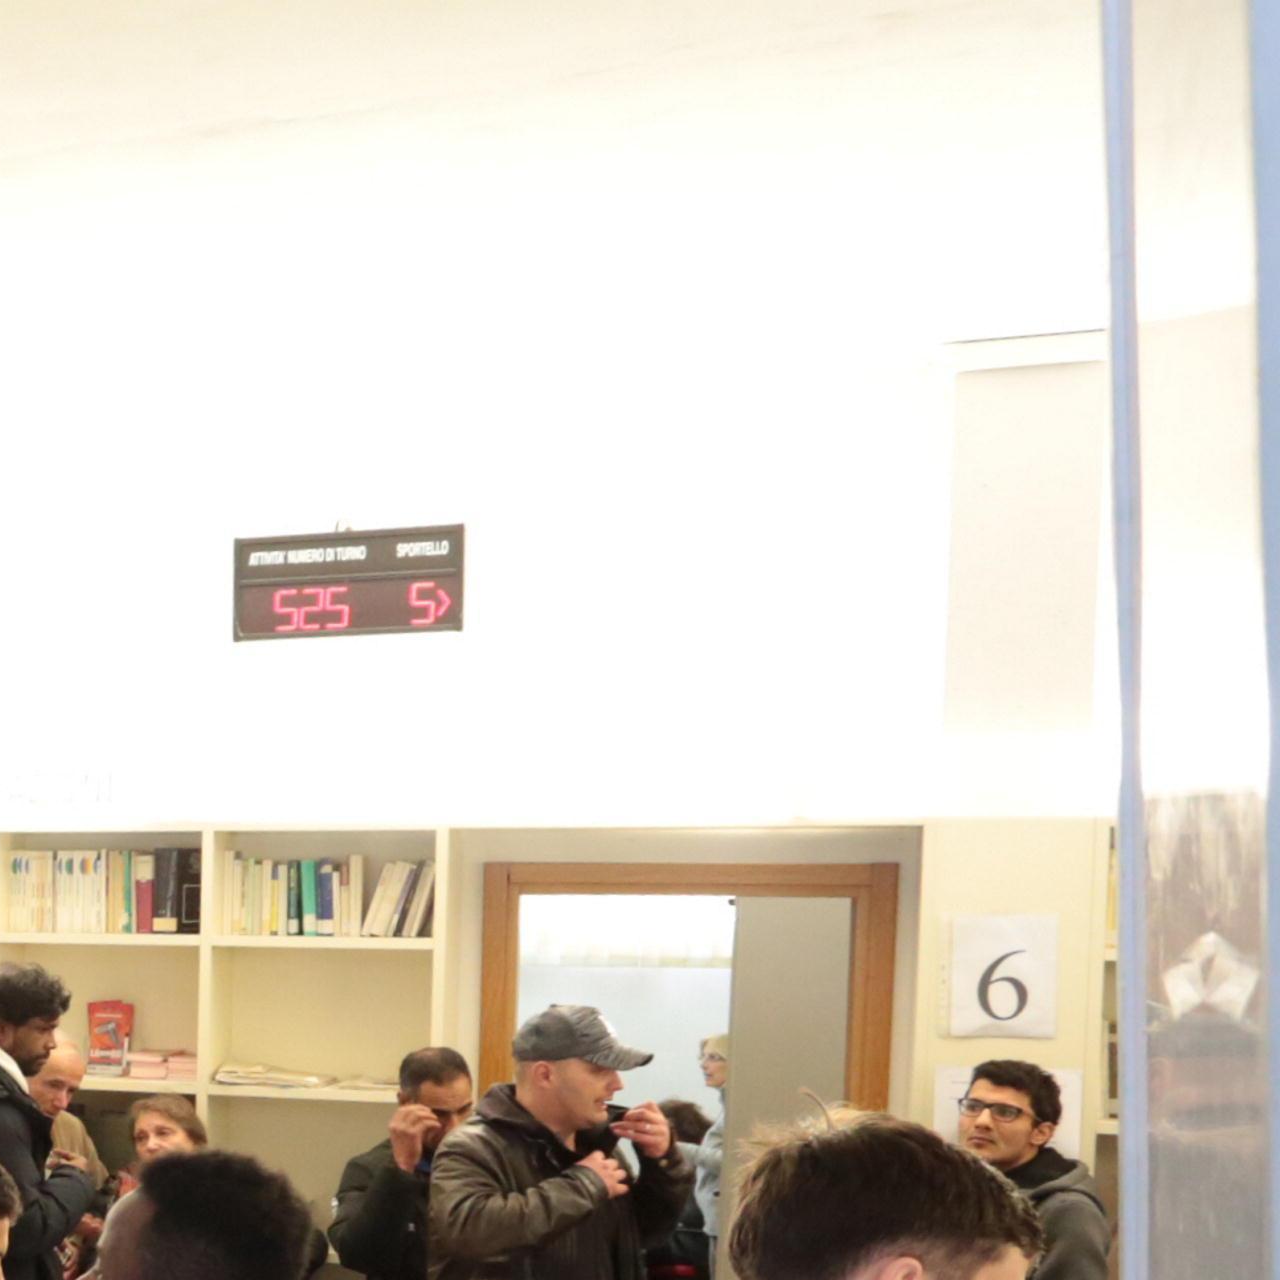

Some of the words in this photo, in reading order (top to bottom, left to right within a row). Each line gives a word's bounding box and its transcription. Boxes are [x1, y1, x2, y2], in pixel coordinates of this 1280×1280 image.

[287, 548, 325, 564] NUMERO
[325, 547, 336, 562] DI
[336, 545, 368, 562] TURNO
[395, 540, 450, 558] SPORTELLO
[273, 586, 350, 632] 525
[408, 581, 436, 626] 5
[976, 948, 1030, 1021] 6
